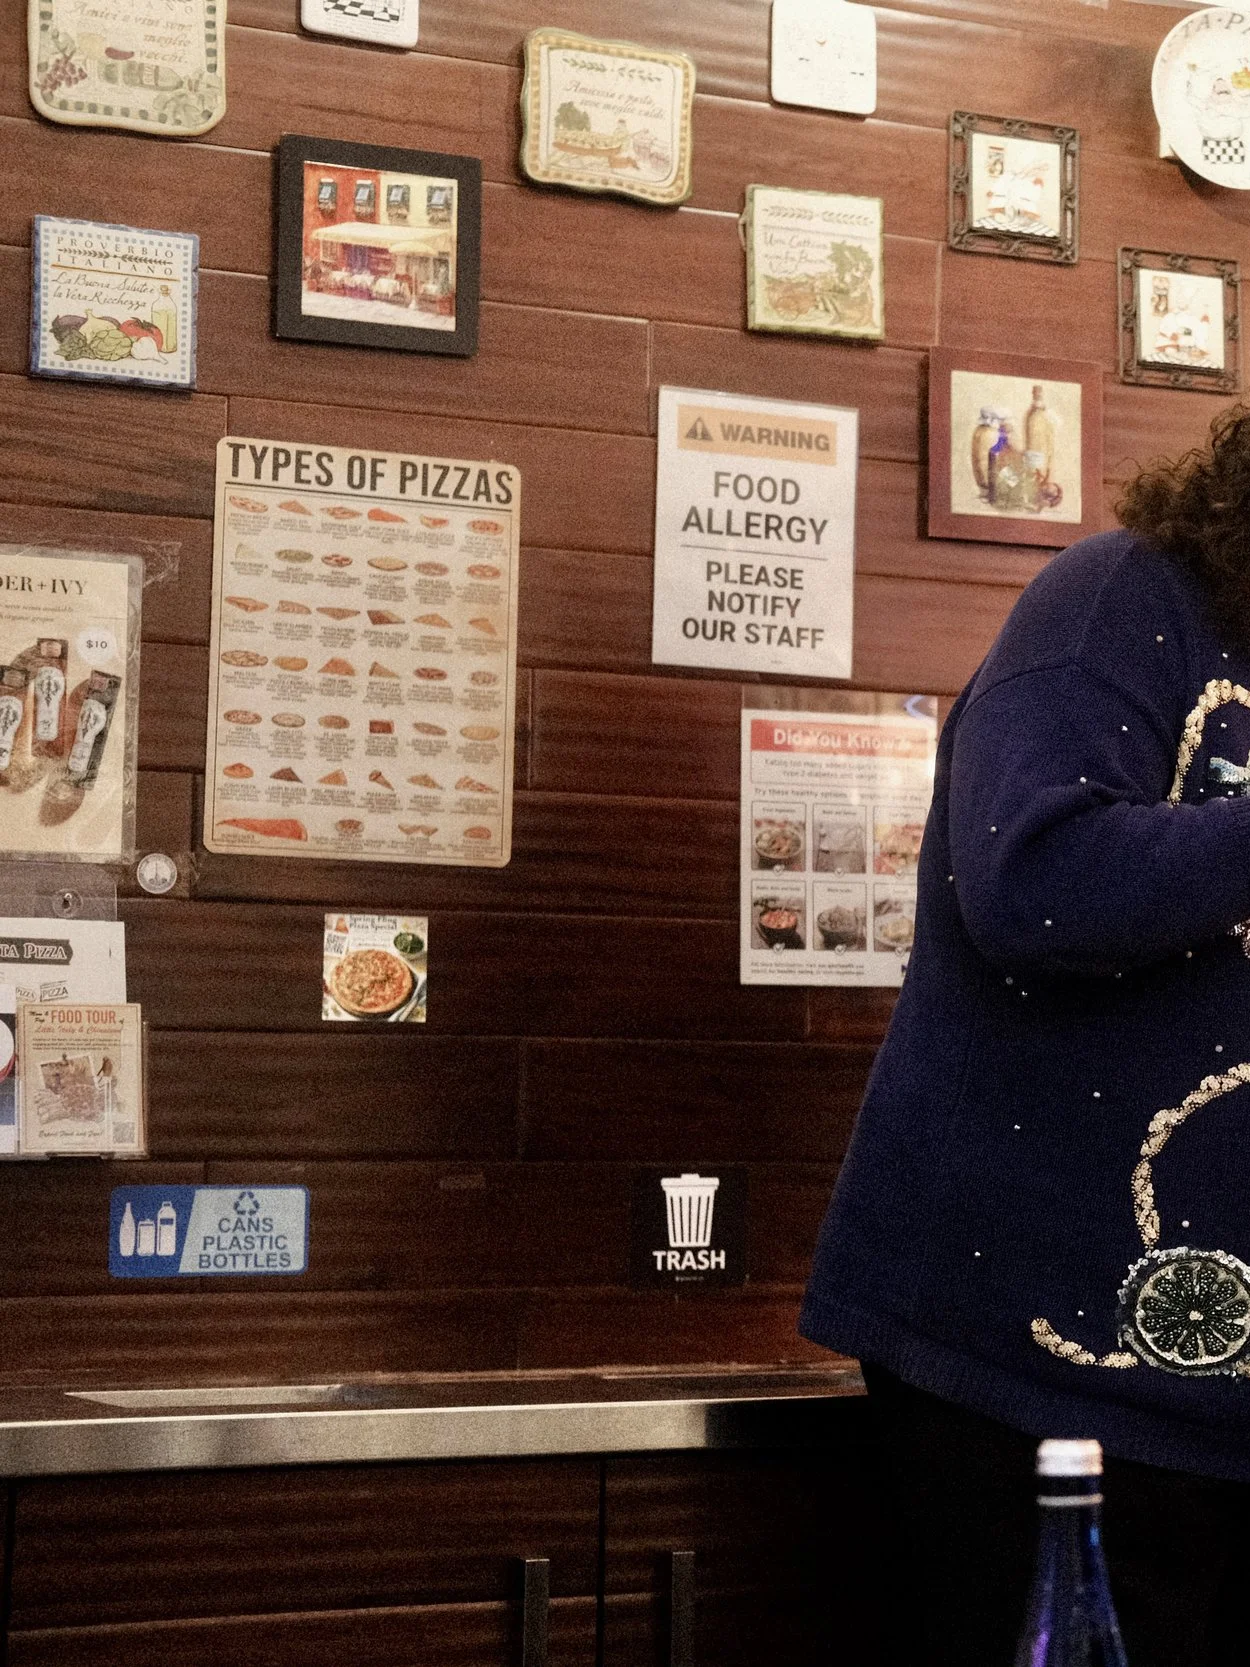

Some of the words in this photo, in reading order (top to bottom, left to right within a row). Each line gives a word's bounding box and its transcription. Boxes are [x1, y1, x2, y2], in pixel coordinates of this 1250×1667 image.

[56, 236, 174, 258] PROVERBIO
[56, 254, 174, 276] ITALIANO
[52, 271, 72, 285] La
[73, 273, 110, 289] Buona
[53, 286, 64, 298] la
[65, 287, 88, 301] Vera
[89, 291, 147, 310] Ricchezza
[720, 422, 830, 452] WARNING
[226, 442, 334, 487] TYPES
[346, 455, 387, 492] OF
[399, 460, 513, 505] PIZZAS
[713, 471, 800, 505] FOOD
[681, 506, 828, 545] ALLERGY
[706, 561, 804, 590] PLEASE
[51, 579, 88, 595] IVY
[707, 590, 801, 618] NOTIFY
[682, 617, 736, 643] OUR
[744, 622, 825, 649] STAFF
[86, 639, 108, 649] $10
[773, 728, 803, 746] Did
[811, 731, 842, 748] You
[791, 788, 818, 798] healthy
[23, 942, 68, 959] PIZZA
[41, 986, 69, 998] PIZZA
[51, 1009, 82, 1023] FOOD
[86, 1010, 117, 1024] TOUR
[218, 1217, 274, 1233] CANS
[202, 1235, 289, 1251] PLASTIC
[198, 1253, 292, 1269] BOTTLES
[652, 1249, 726, 1271] TRASH
